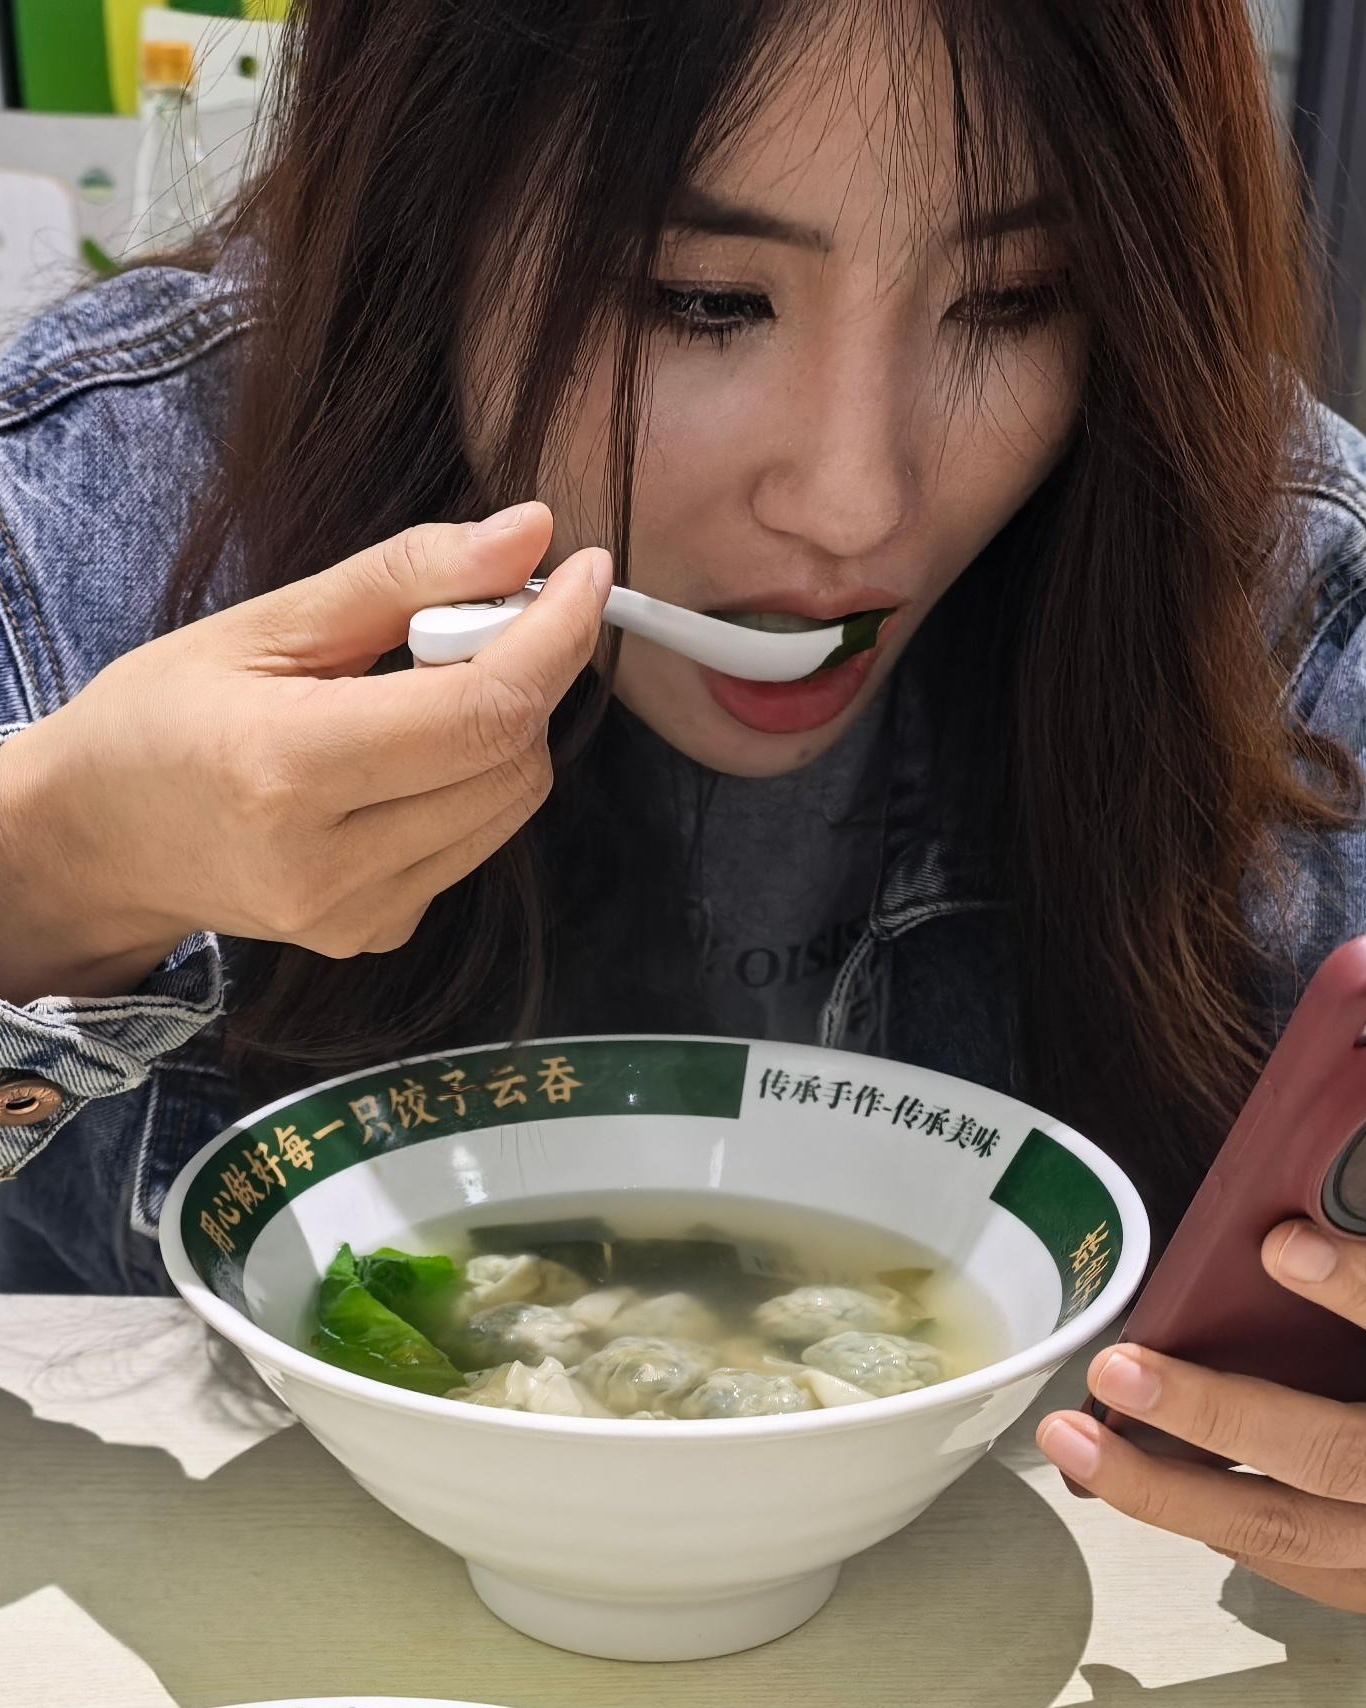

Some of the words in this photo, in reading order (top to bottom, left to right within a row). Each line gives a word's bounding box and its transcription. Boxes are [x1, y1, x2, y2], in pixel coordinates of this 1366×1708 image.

[198, 1055, 584, 1255] 用心做好每一只饺子云吞
[759, 1068, 1001, 1158] 传承手作-传承美味
